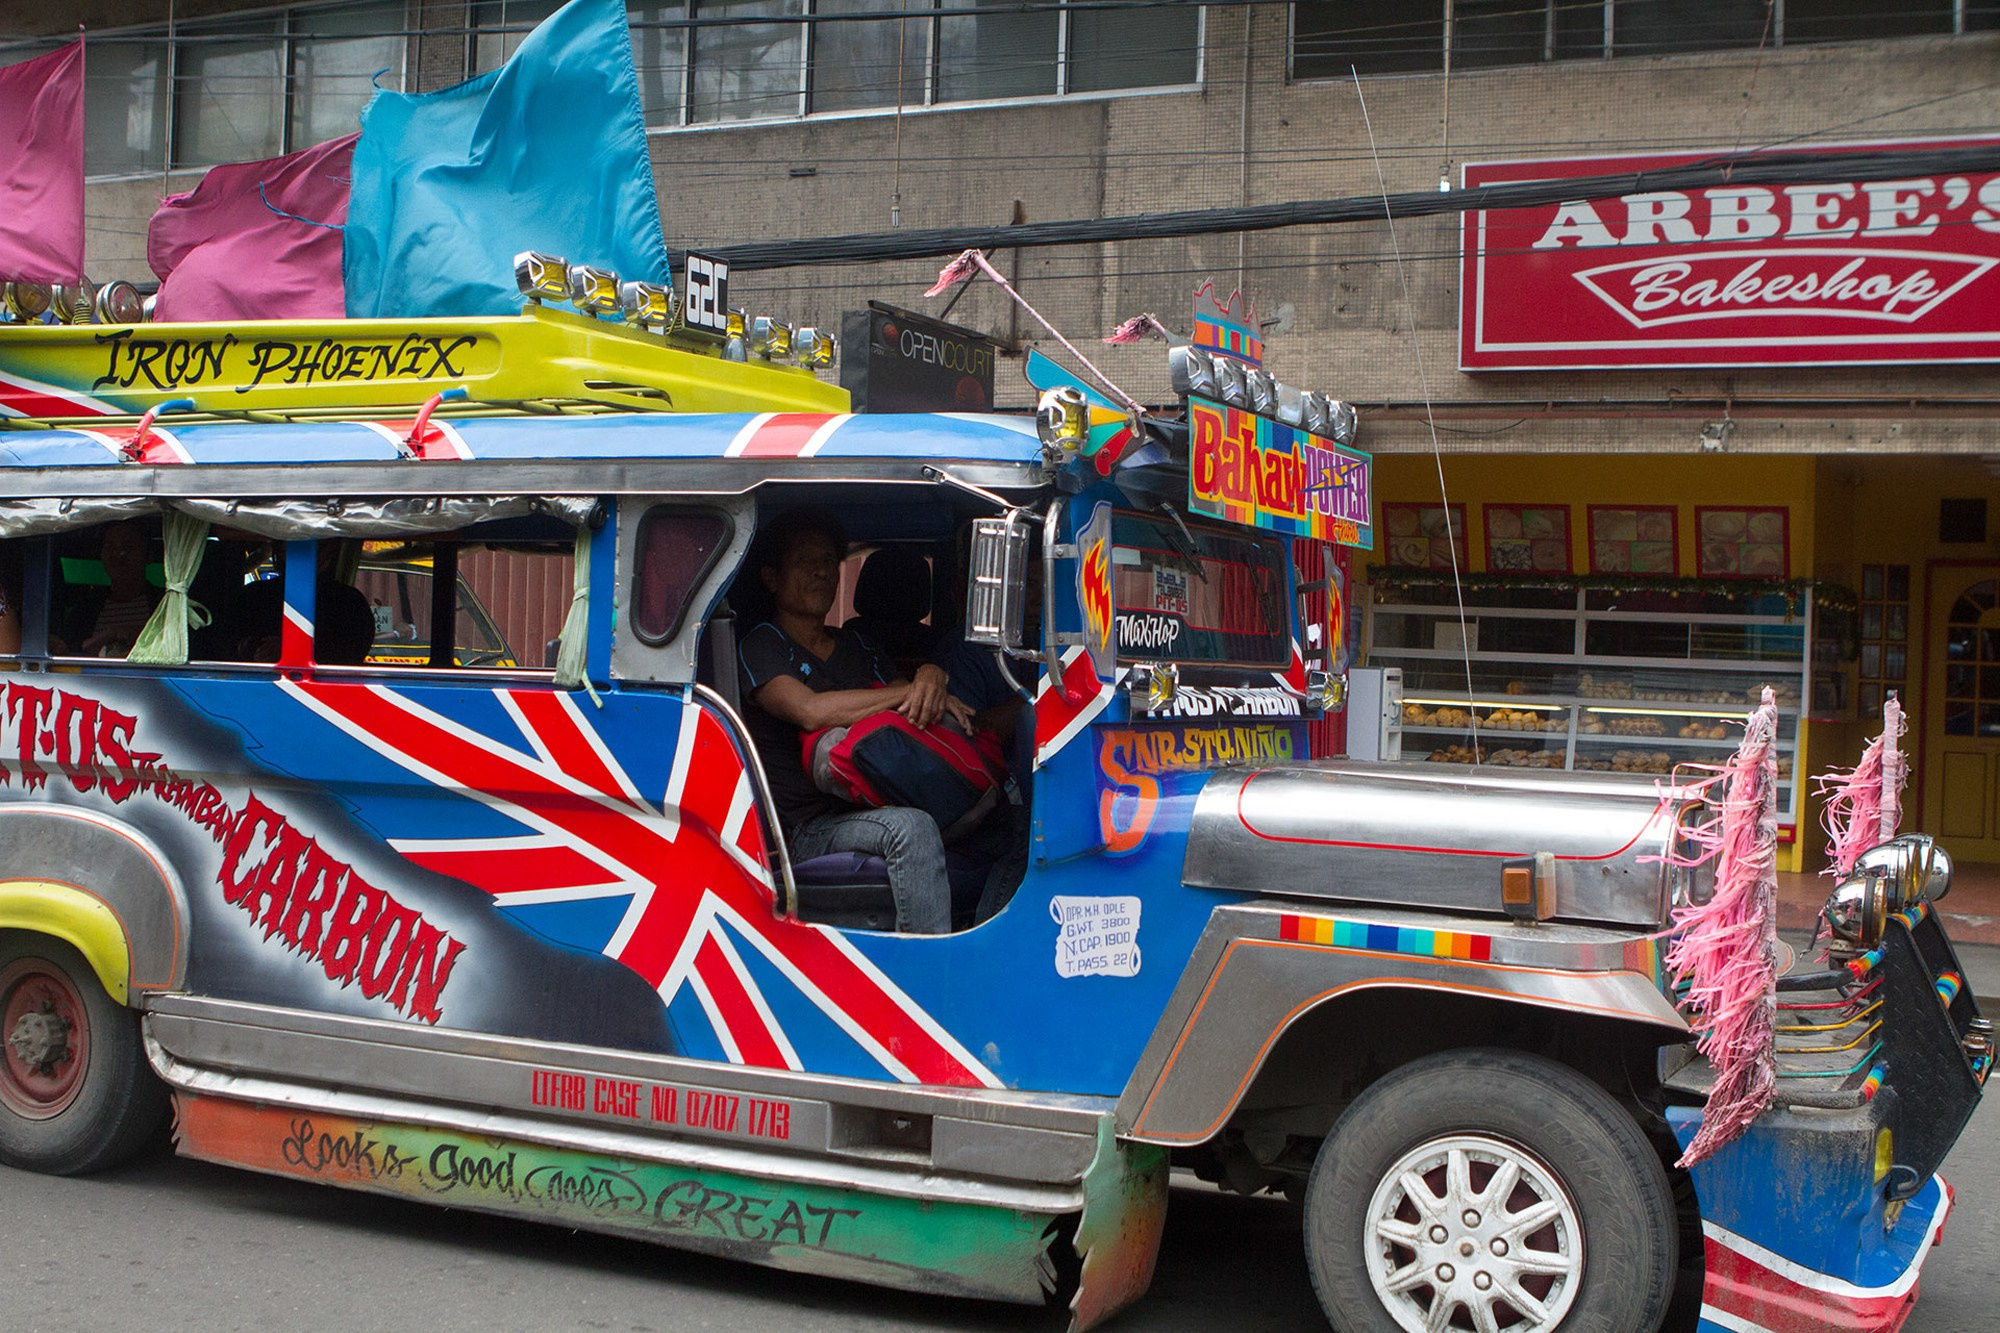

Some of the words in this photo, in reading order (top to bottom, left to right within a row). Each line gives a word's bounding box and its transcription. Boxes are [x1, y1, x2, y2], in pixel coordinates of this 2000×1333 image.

[686, 255, 728, 330] 62C
[1630, 257, 1940, 312] Bakeshop
[92, 329, 239, 392] IRON
[1303, 443, 1370, 525] POWER
[0, 680, 138, 804] T-OS
[217, 789, 467, 1025] CARBON
[1101, 917, 1130, 930] 3800
[1103, 903, 1126, 915] OPLE
[1105, 931, 1131, 946] 1900
[1113, 953, 1128, 966] 22
[532, 1069, 586, 1111] LTFRB
[594, 1078, 642, 1119] CASE
[748, 1099, 790, 1140] 1713
[282, 1118, 419, 1179] Looks
[652, 1180, 863, 1249] GREAT
